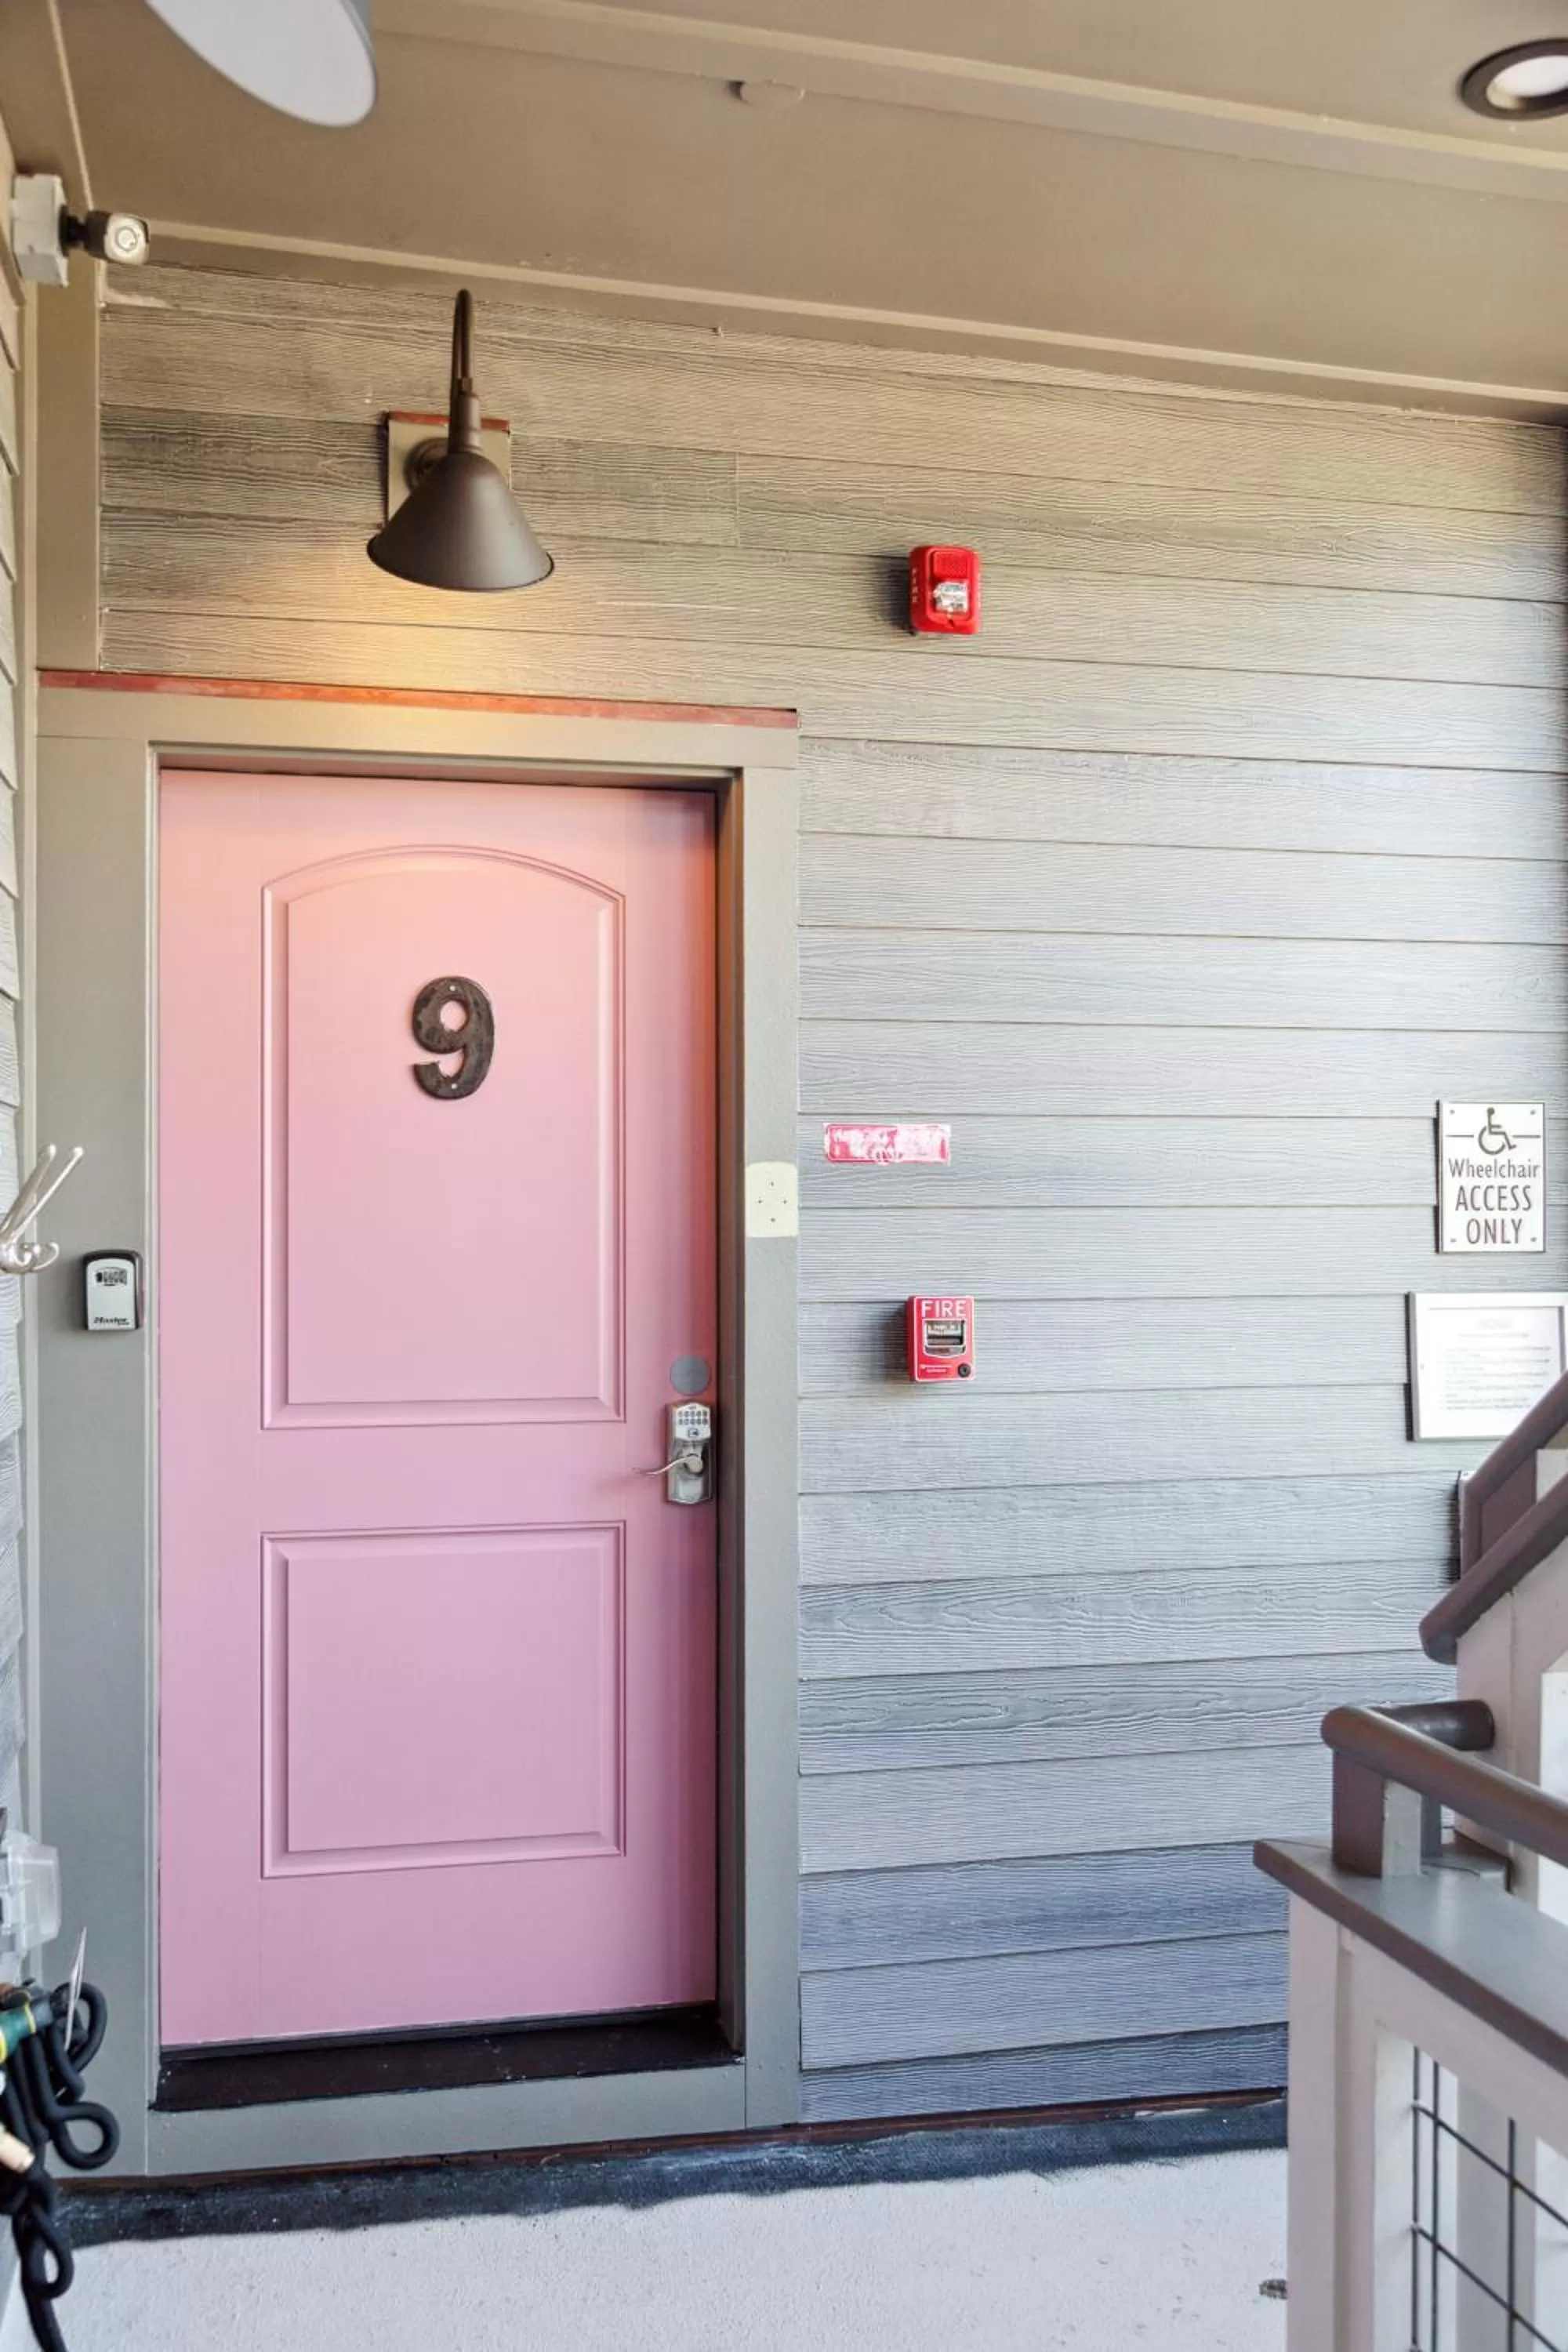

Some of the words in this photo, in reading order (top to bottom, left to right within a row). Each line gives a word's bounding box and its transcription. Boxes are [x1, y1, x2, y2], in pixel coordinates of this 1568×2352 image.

[412, 976, 495, 1100] 9
[1448, 1158, 1540, 1178] Wheelchair
[1455, 1185, 1531, 1210] ACCESS
[1466, 1218, 1523, 1244] ONLY
[921, 1300, 966, 1317] FIRE
